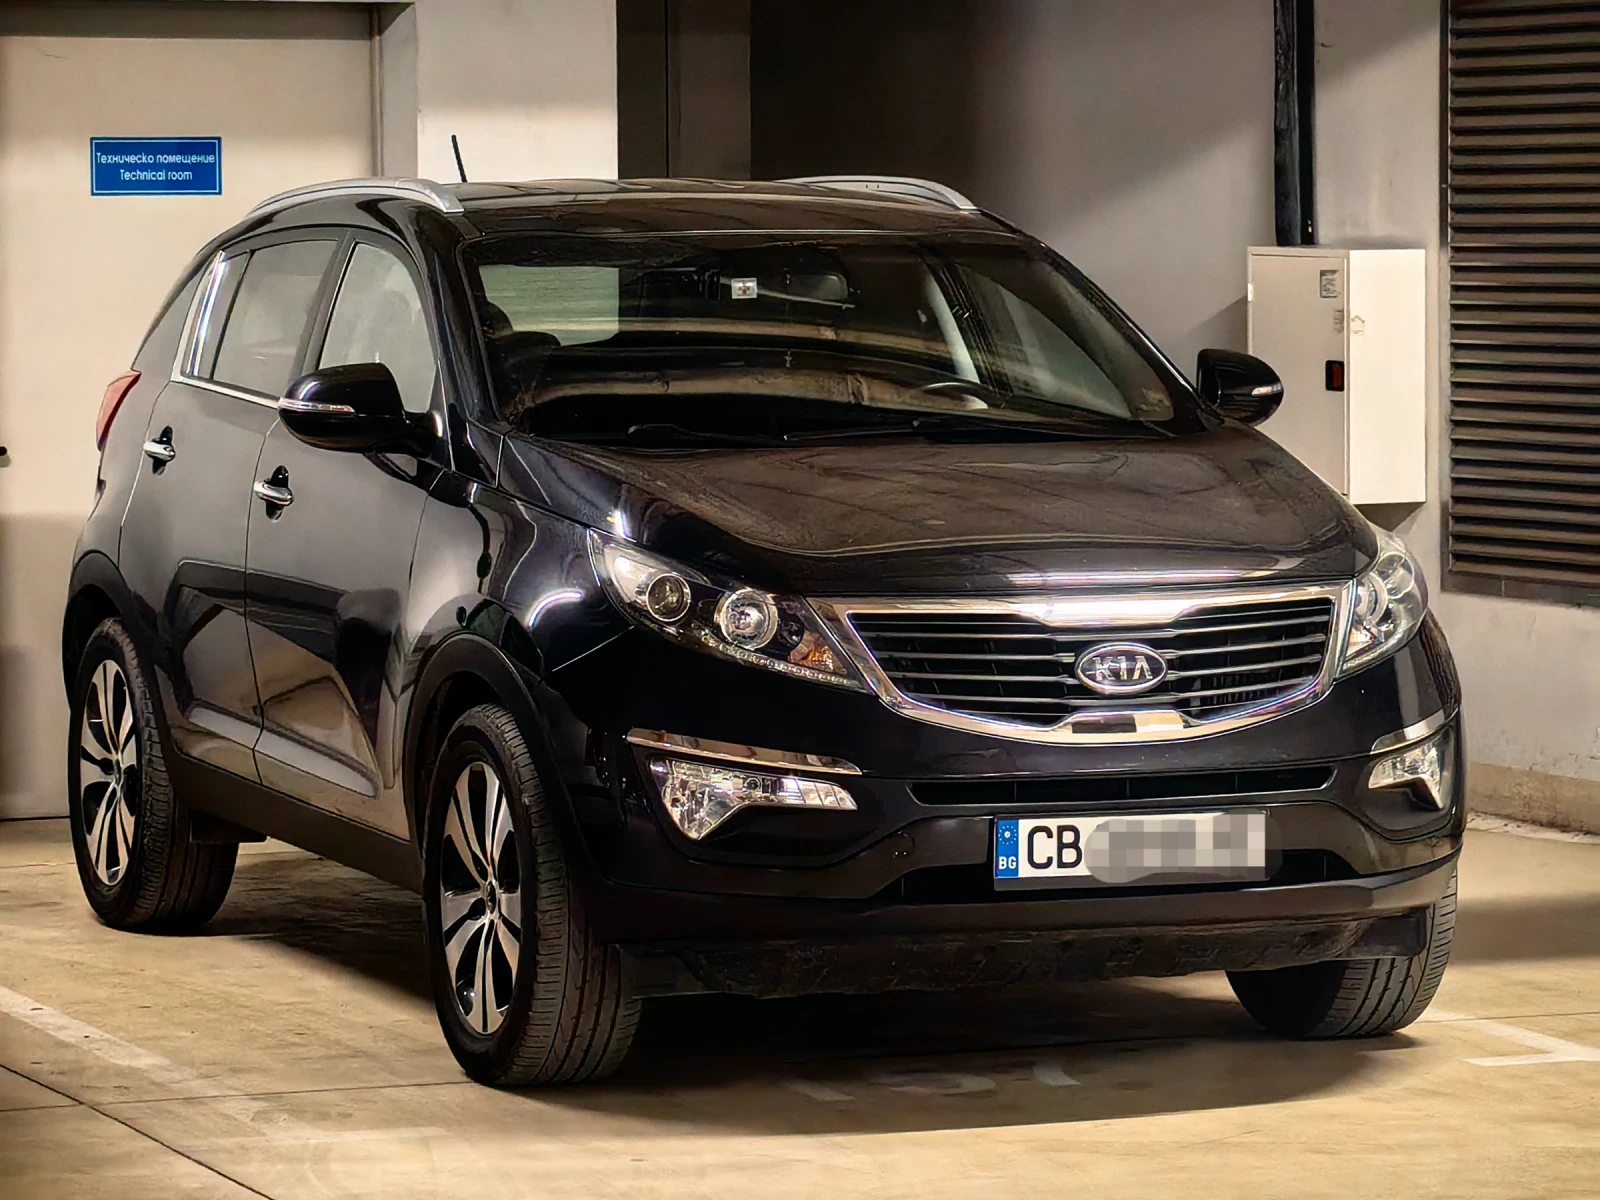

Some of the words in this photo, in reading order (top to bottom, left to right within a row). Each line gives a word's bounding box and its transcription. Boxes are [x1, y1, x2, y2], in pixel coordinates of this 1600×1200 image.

[96, 152, 154, 164] Техническо
[156, 154, 215, 165] помещение
[119, 169, 166, 181] Technical
[168, 171, 193, 181] room
[1092, 655, 1153, 681] KIA
[998, 856, 1017, 870] BG
